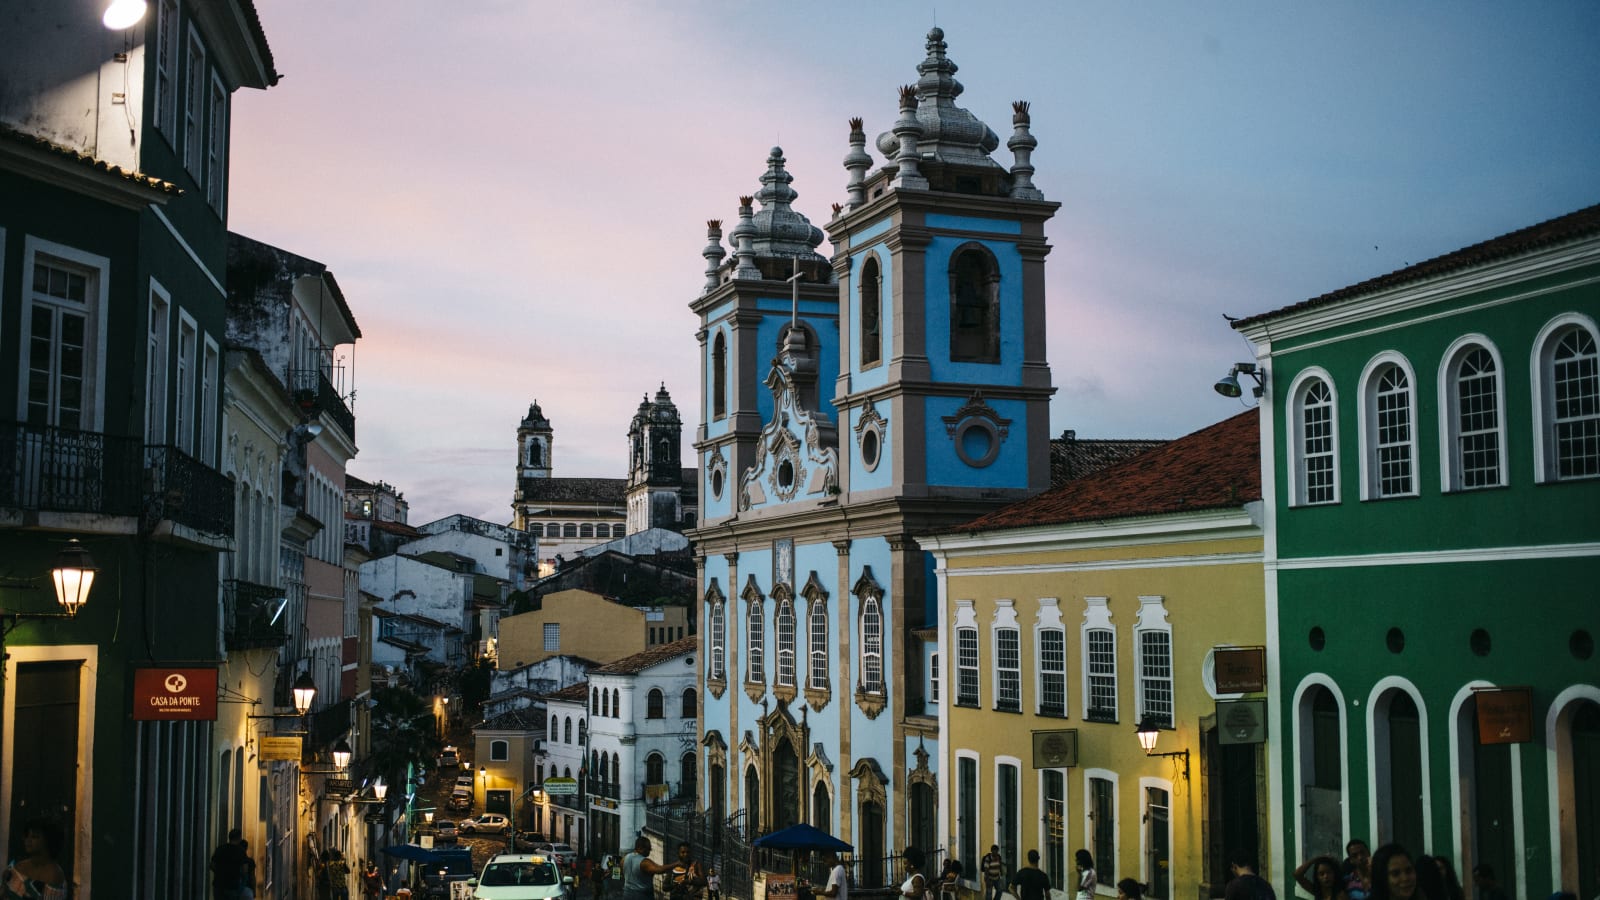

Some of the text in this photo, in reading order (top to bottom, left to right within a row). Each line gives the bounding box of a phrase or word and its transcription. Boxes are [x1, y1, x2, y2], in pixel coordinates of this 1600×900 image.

[150, 696, 200, 706] CASA DA PONTE
